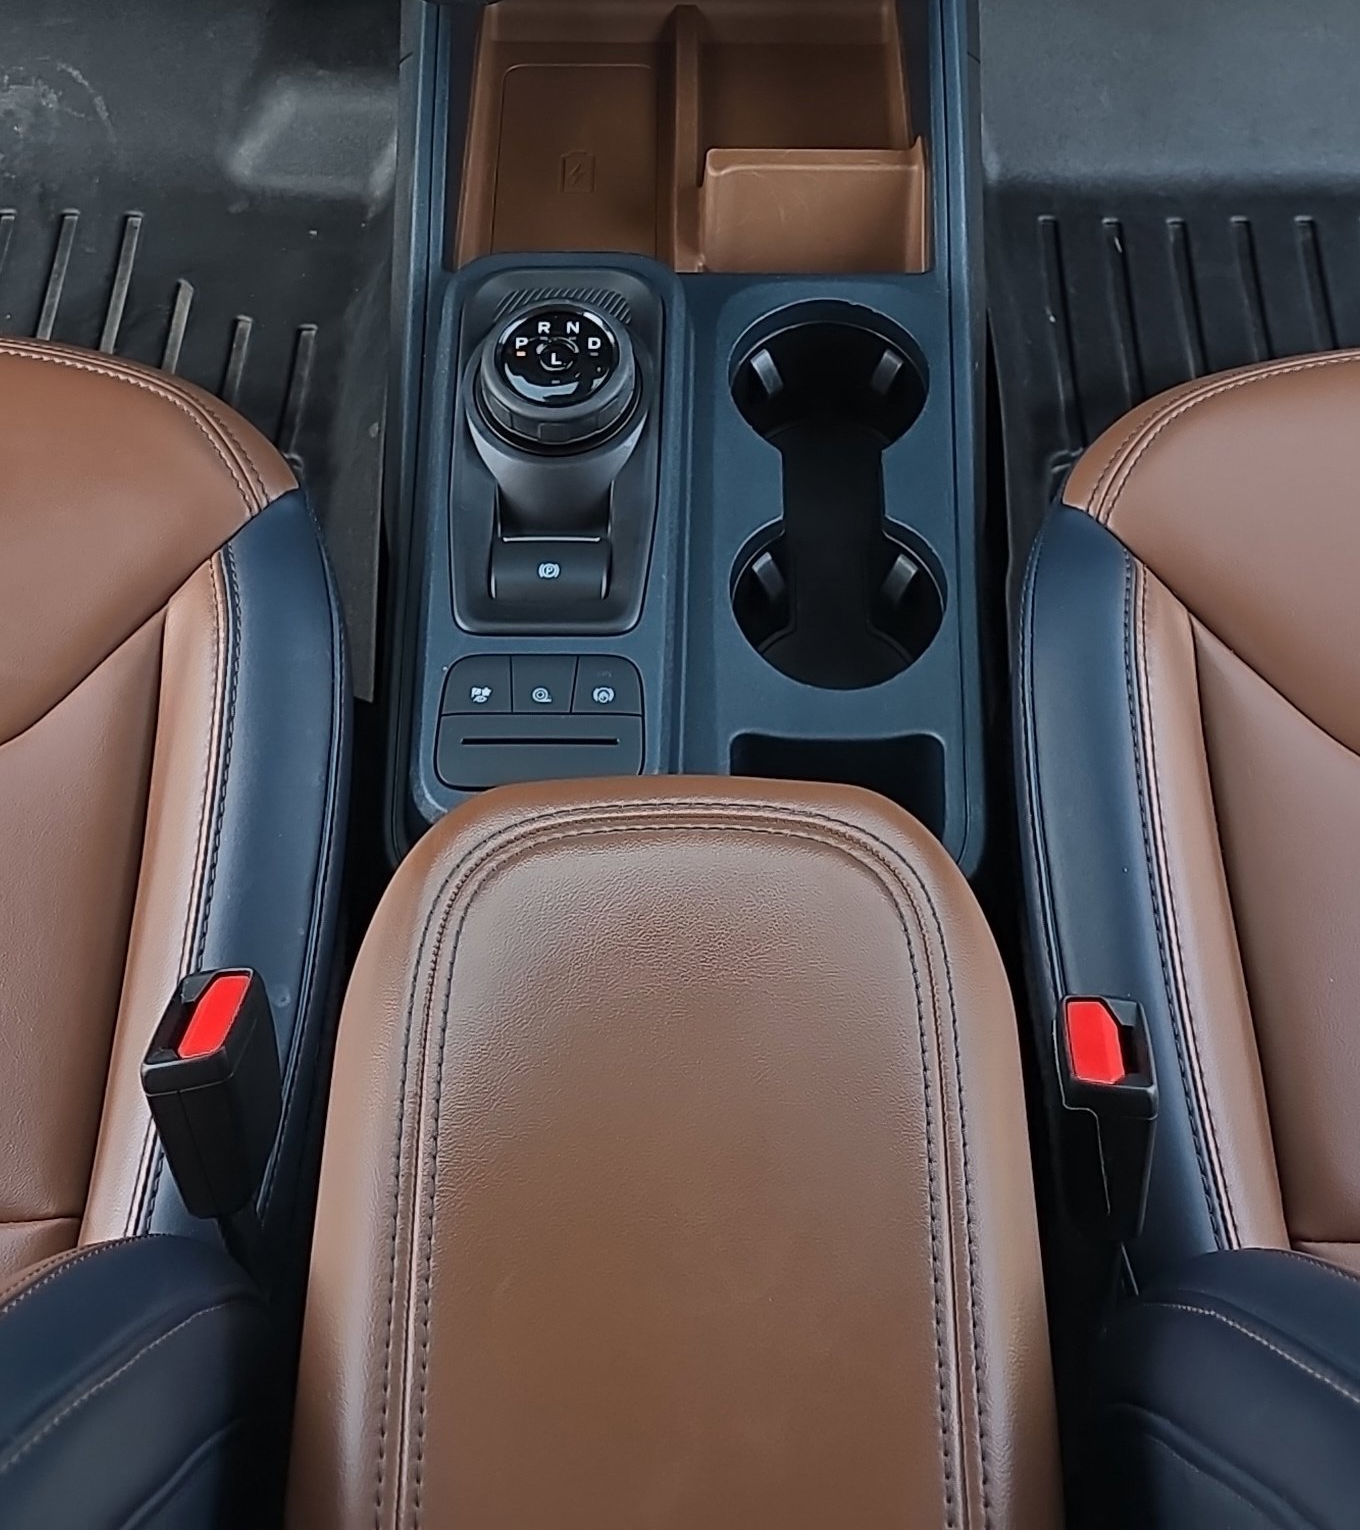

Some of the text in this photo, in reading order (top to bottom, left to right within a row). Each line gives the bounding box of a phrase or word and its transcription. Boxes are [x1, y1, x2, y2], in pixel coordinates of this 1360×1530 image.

[537, 321, 552, 335] R
[566, 321, 580, 335] N
[515, 337, 529, 350] P
[587, 337, 602, 350] D
[550, 352, 563, 366] L
